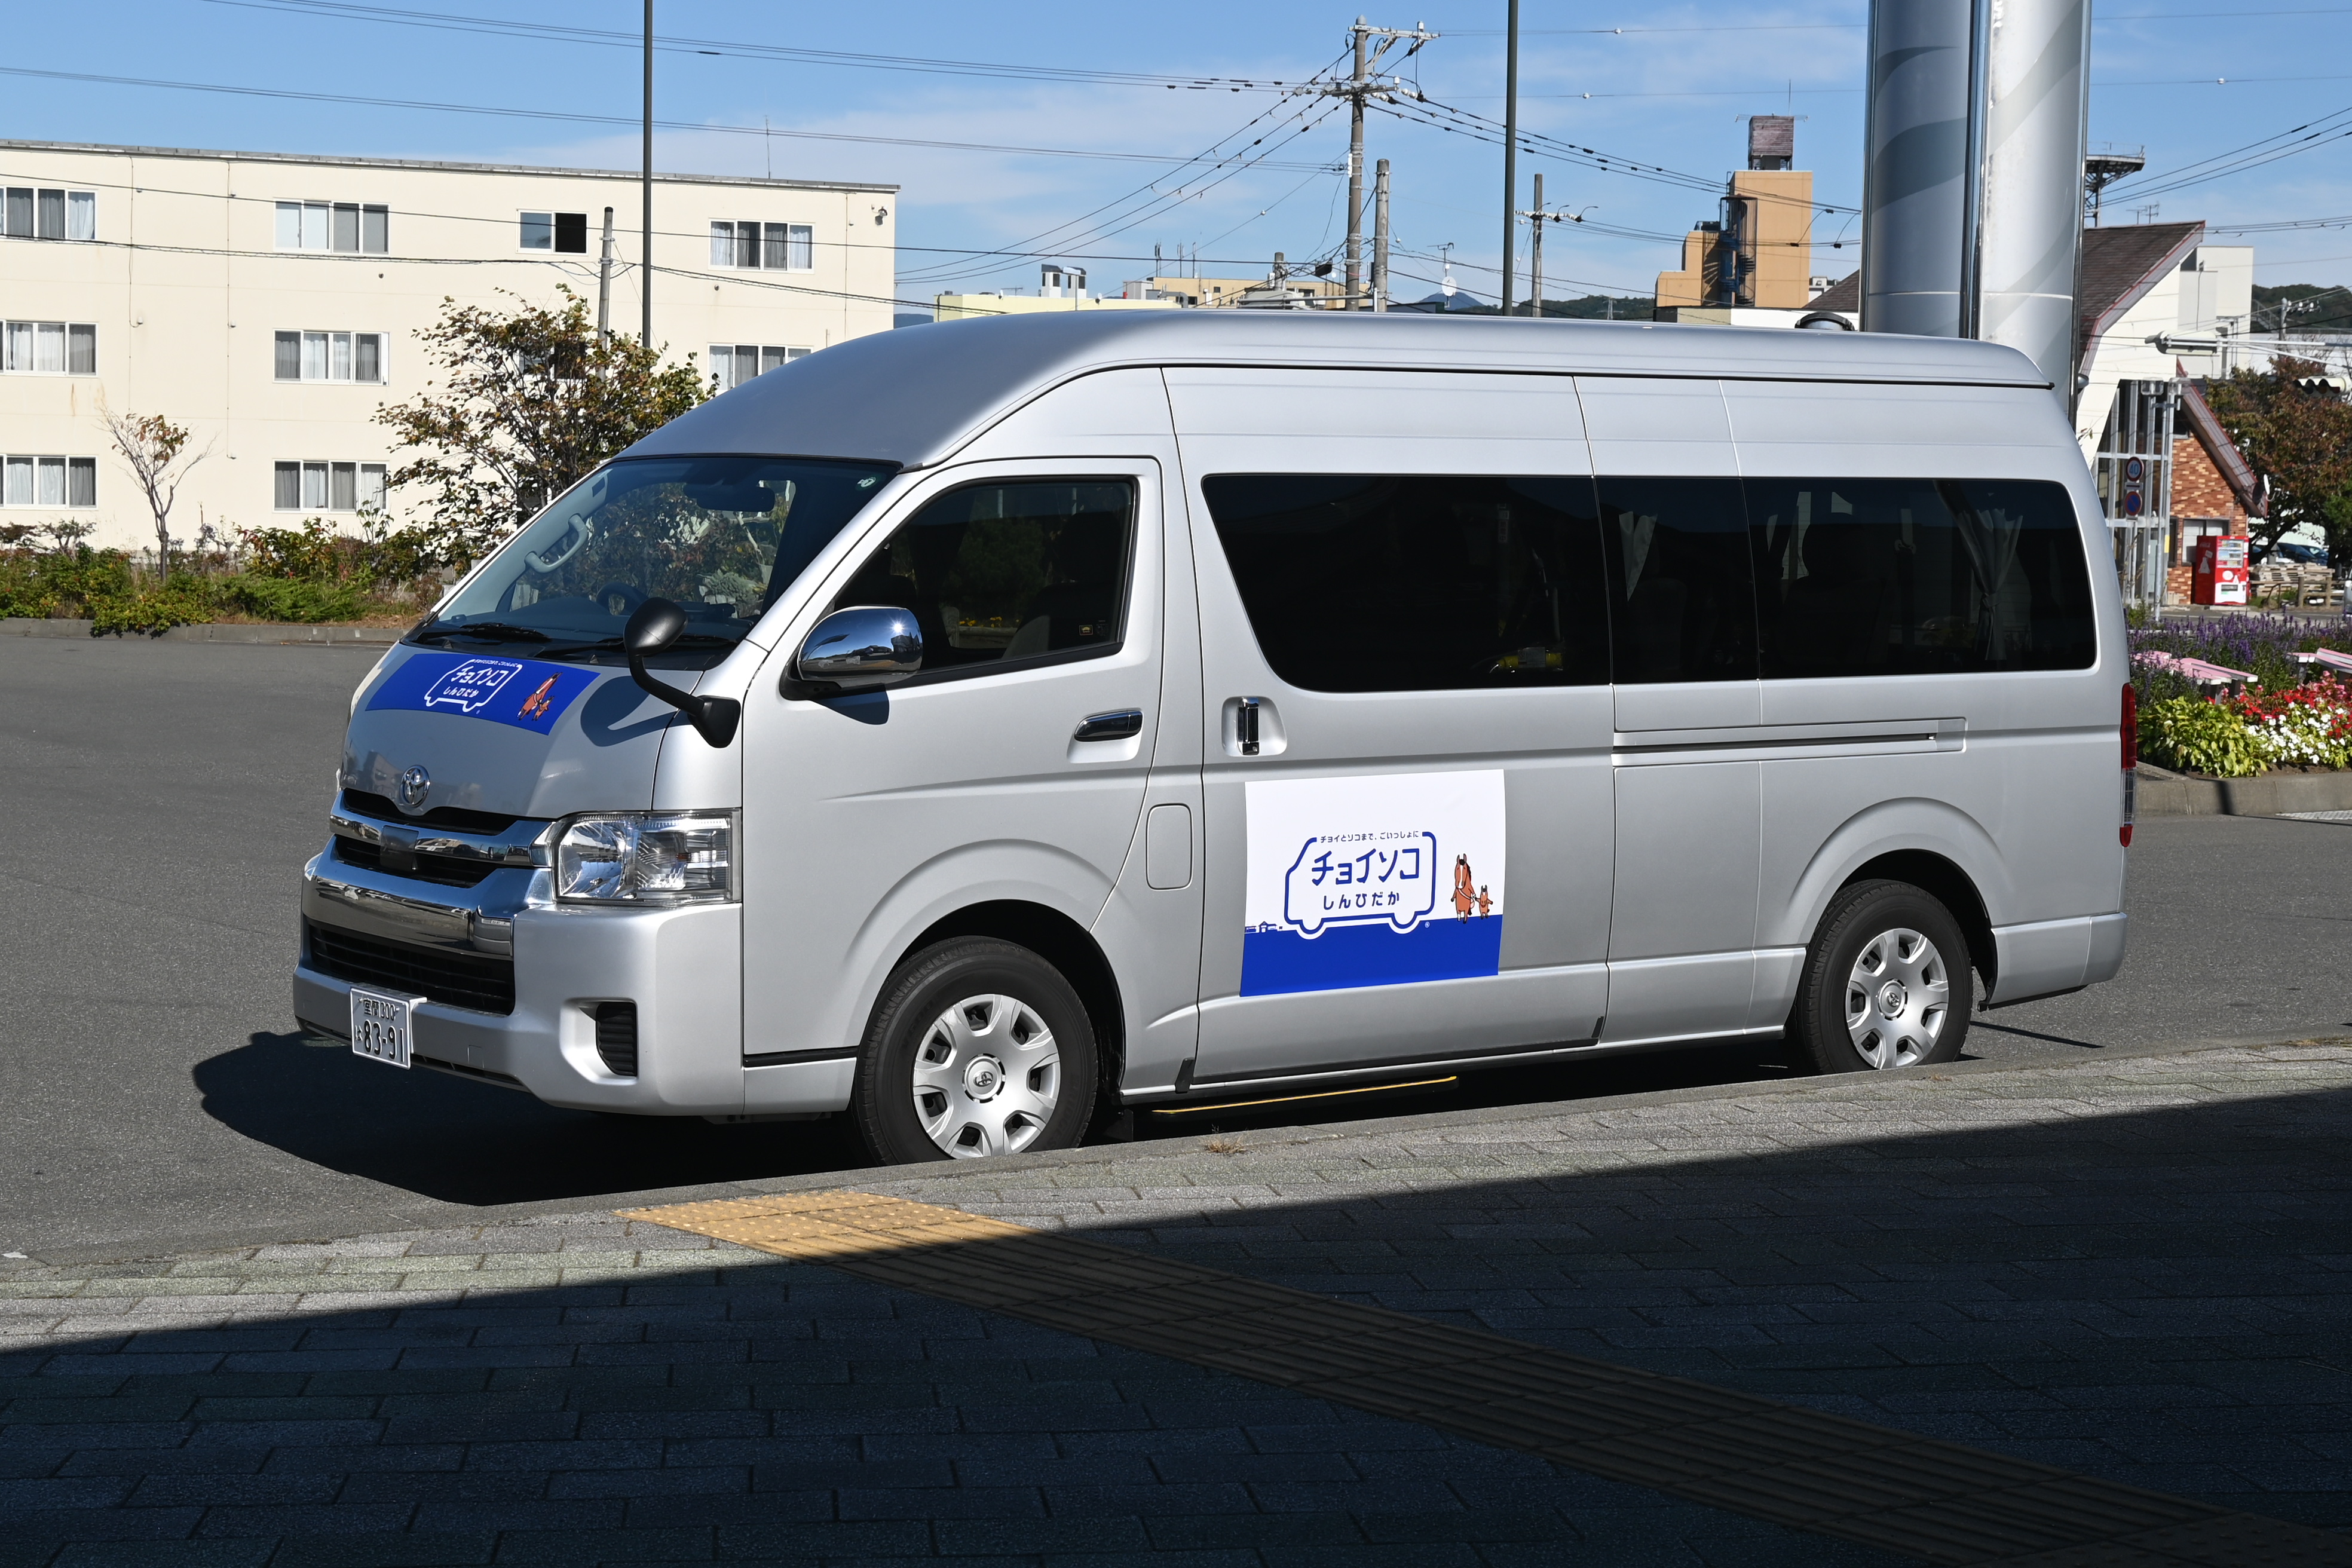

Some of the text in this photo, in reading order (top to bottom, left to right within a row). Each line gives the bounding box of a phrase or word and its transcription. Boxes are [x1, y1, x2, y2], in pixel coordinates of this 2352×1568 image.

[2129, 464, 2139, 475] 40
[451, 666, 509, 687] チョイソコ
[1311, 848, 1420, 887] チョイソコ
[1323, 891, 1400, 911] しんひだか
